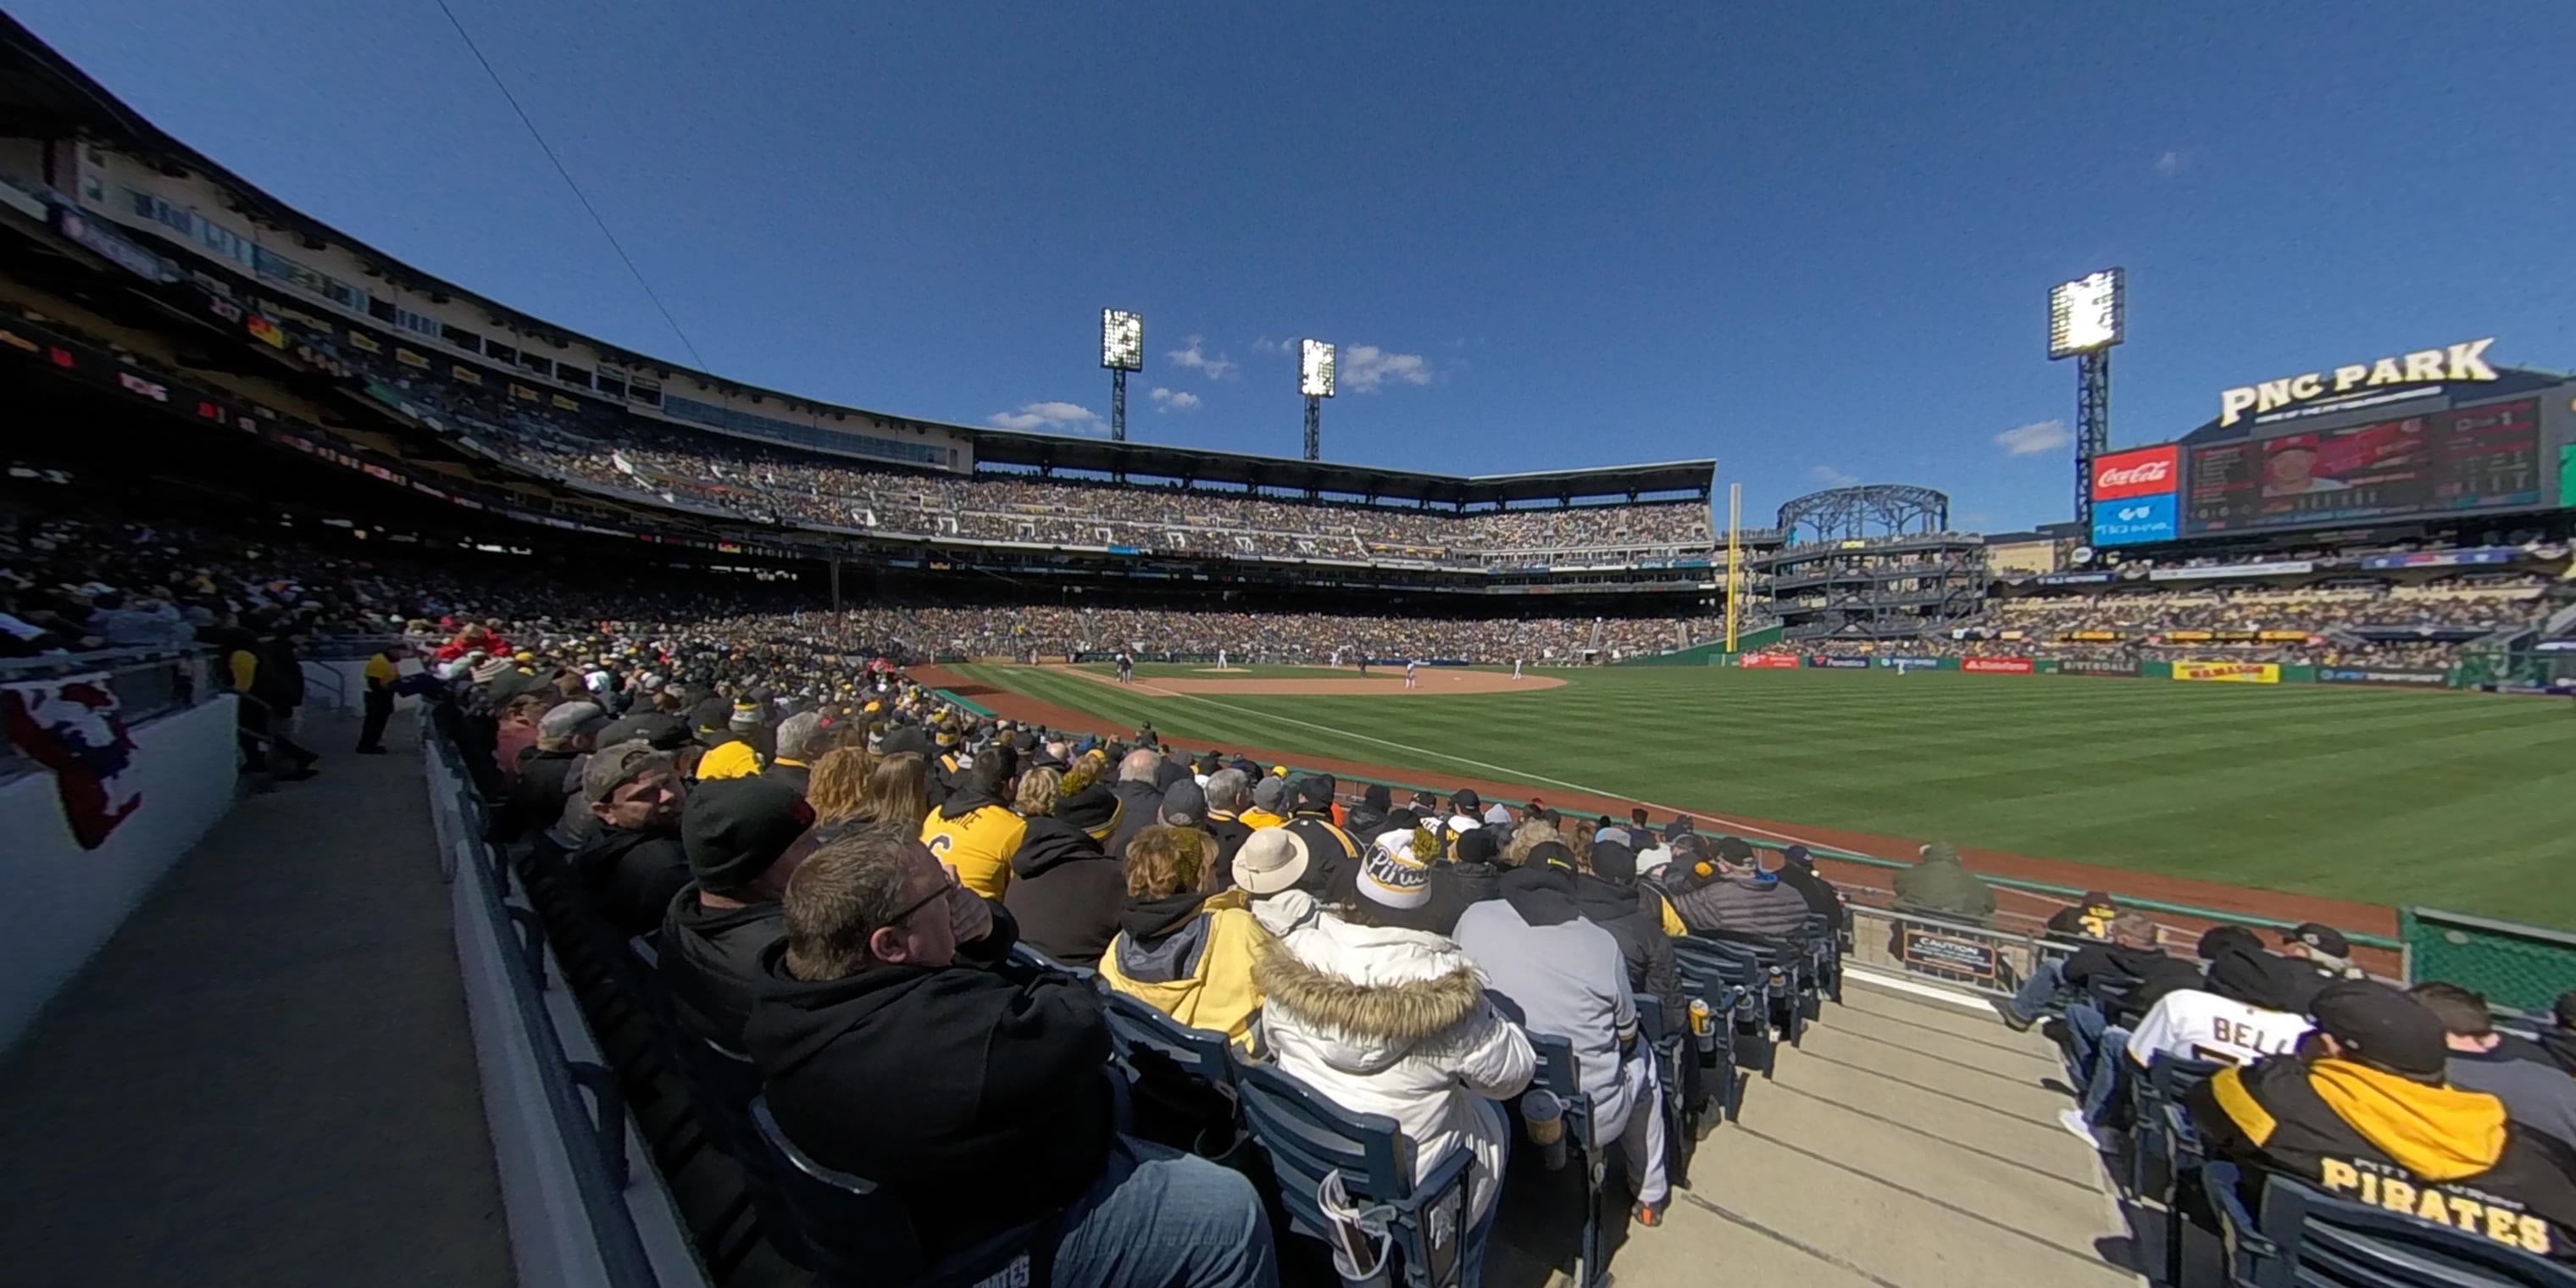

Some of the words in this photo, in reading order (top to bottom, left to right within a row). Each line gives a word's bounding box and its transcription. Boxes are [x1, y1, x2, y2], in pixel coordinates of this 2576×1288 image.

[2220, 373, 2324, 428] PNC
[2334, 337, 2499, 392] PARK
[1918, 936, 1979, 955] CAUTION
[2320, 1156, 2551, 1255] PIRATES
